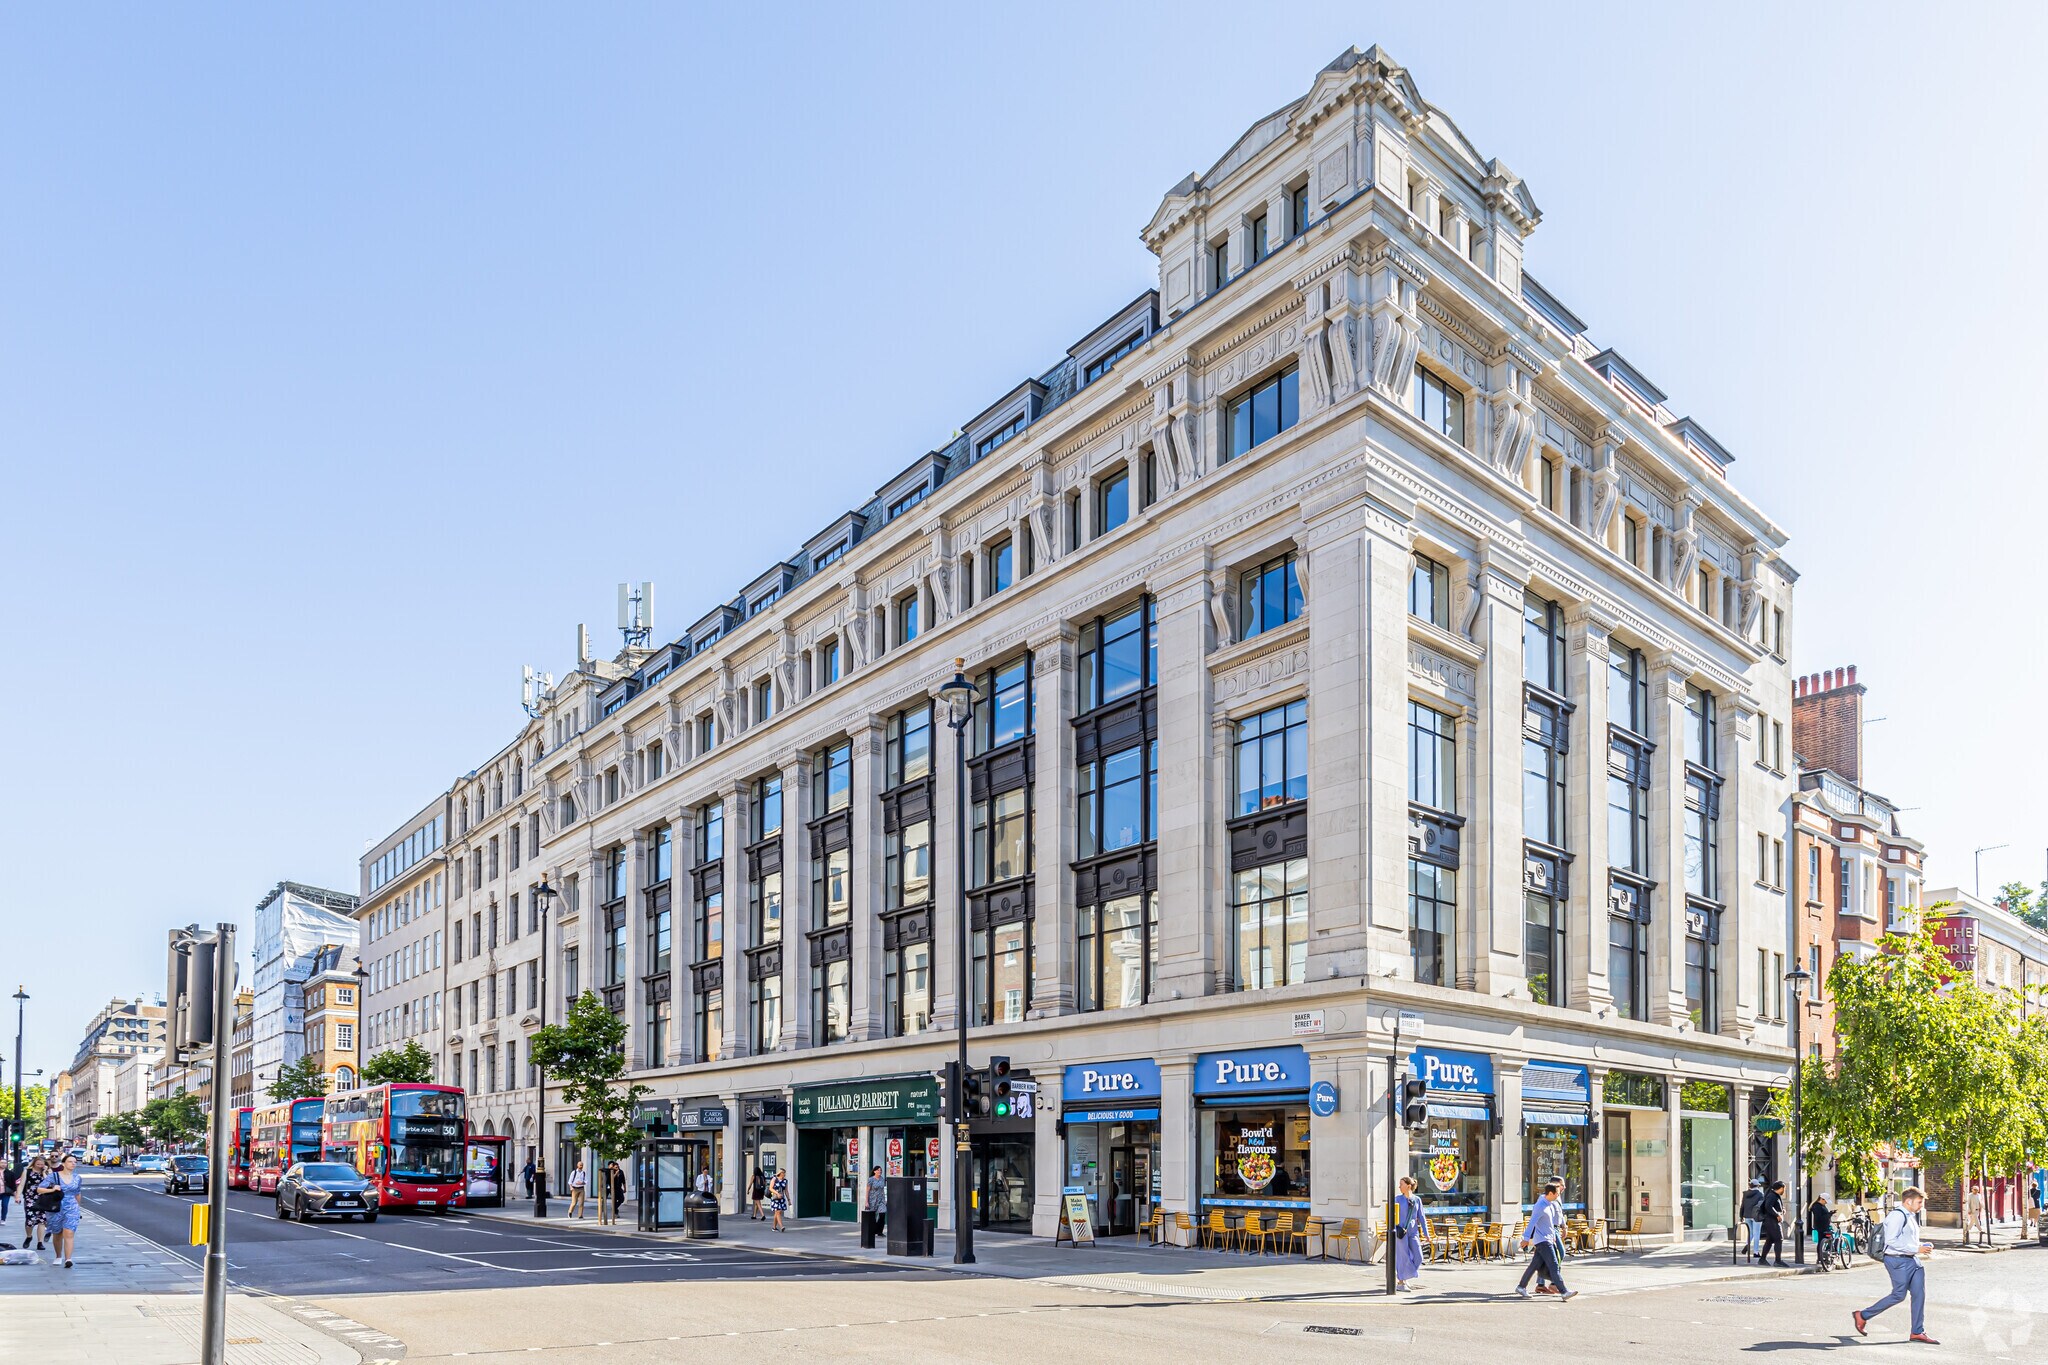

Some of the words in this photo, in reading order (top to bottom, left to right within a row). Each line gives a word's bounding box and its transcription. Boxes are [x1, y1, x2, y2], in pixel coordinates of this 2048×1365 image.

[1942, 928, 1972, 938] THE
[1216, 1060, 1288, 1084] Pure.
[1424, 1055, 1478, 1084] Pure.
[1082, 1070, 1139, 1092] Pure.
[910, 1089, 928, 1098] natural
[1316, 1093, 1335, 1102] Pure.
[817, 1094, 852, 1113] HOLLAND
[852, 1094, 861, 1111] &
[861, 1091, 899, 1109] BARRETT
[682, 1115, 698, 1124] CARDS
[1088, 1111, 1118, 1120] DELICIOUSLY
[442, 1126, 455, 1135] 30
[1237, 1144, 1277, 1154] flavours
[1429, 1145, 1459, 1154] flavours
[763, 1155, 768, 1166] TO
